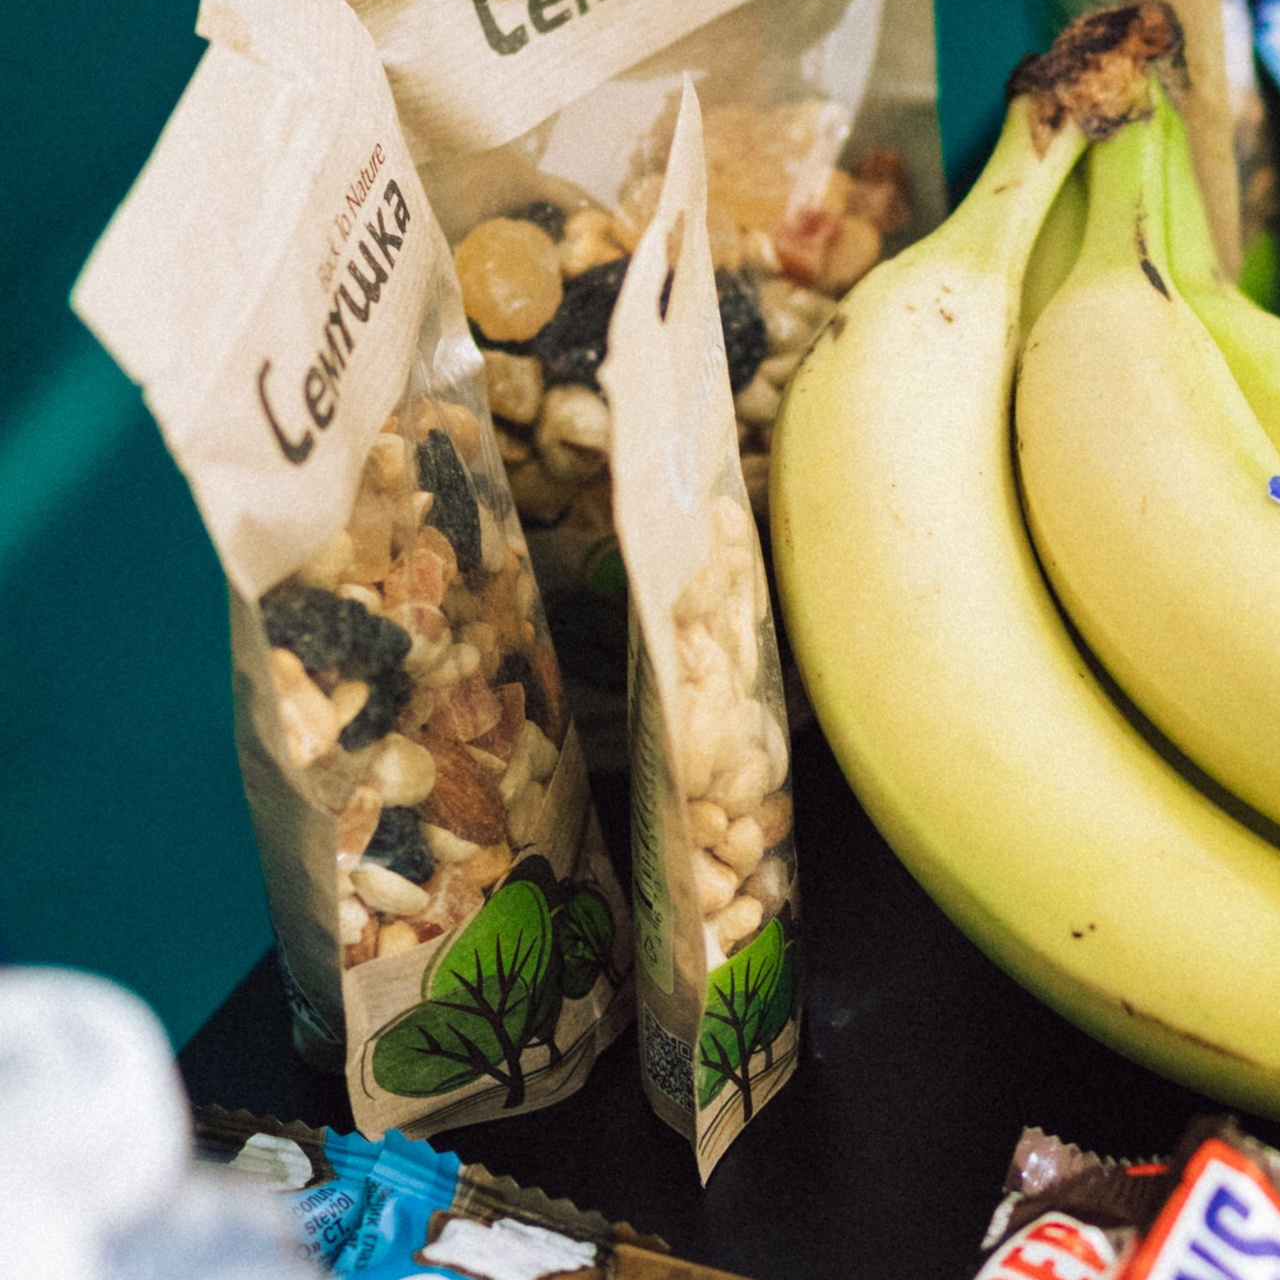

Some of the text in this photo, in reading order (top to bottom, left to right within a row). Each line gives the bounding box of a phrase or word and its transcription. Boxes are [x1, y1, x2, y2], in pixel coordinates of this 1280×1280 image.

[257, 179, 411, 465] Семушка
[317, 143, 386, 293] Back To Nature
